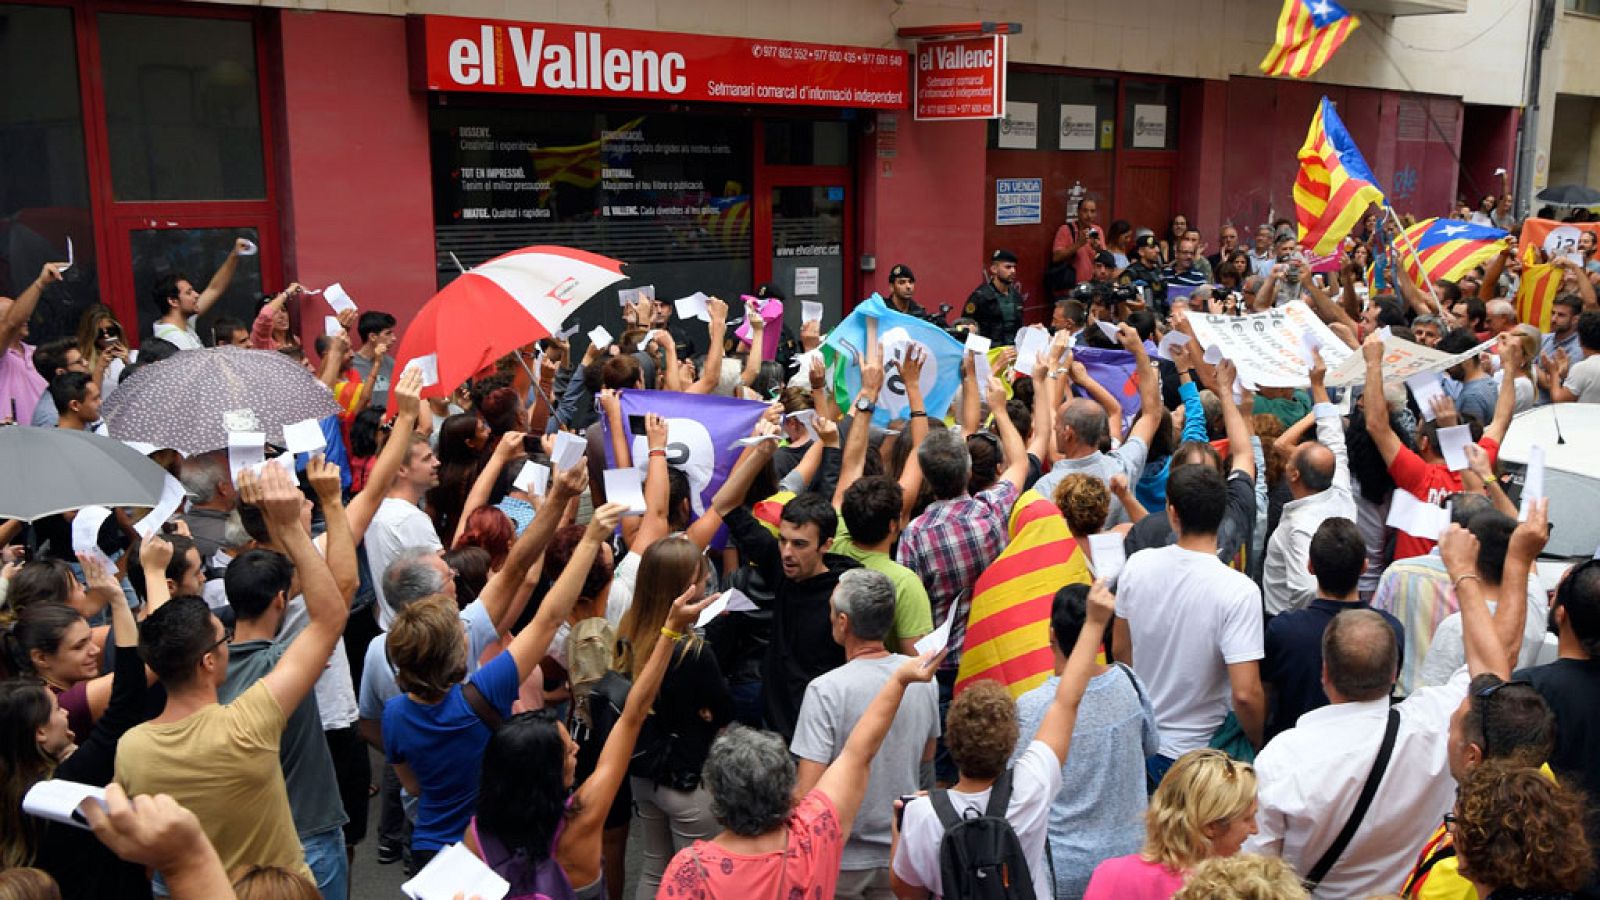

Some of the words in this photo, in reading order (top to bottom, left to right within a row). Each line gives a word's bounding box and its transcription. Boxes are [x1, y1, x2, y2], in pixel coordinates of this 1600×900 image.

[449, 25, 496, 85] el
[508, 27, 687, 94] Vallenc
[920, 46, 934, 71] el
[936, 44, 993, 70] Vallenc
[708, 80, 755, 97] Setmanari
[757, 85, 798, 100] comarcal
[800, 85, 851, 102] d'informació
[854, 89, 903, 106] independent
[461, 168, 474, 178] TOT
[476, 168, 485, 178] EN
[1000, 181, 1011, 193] EN
[1012, 180, 1040, 193] VENDA
[776, 244, 840, 257] www.elvallenc.cat
